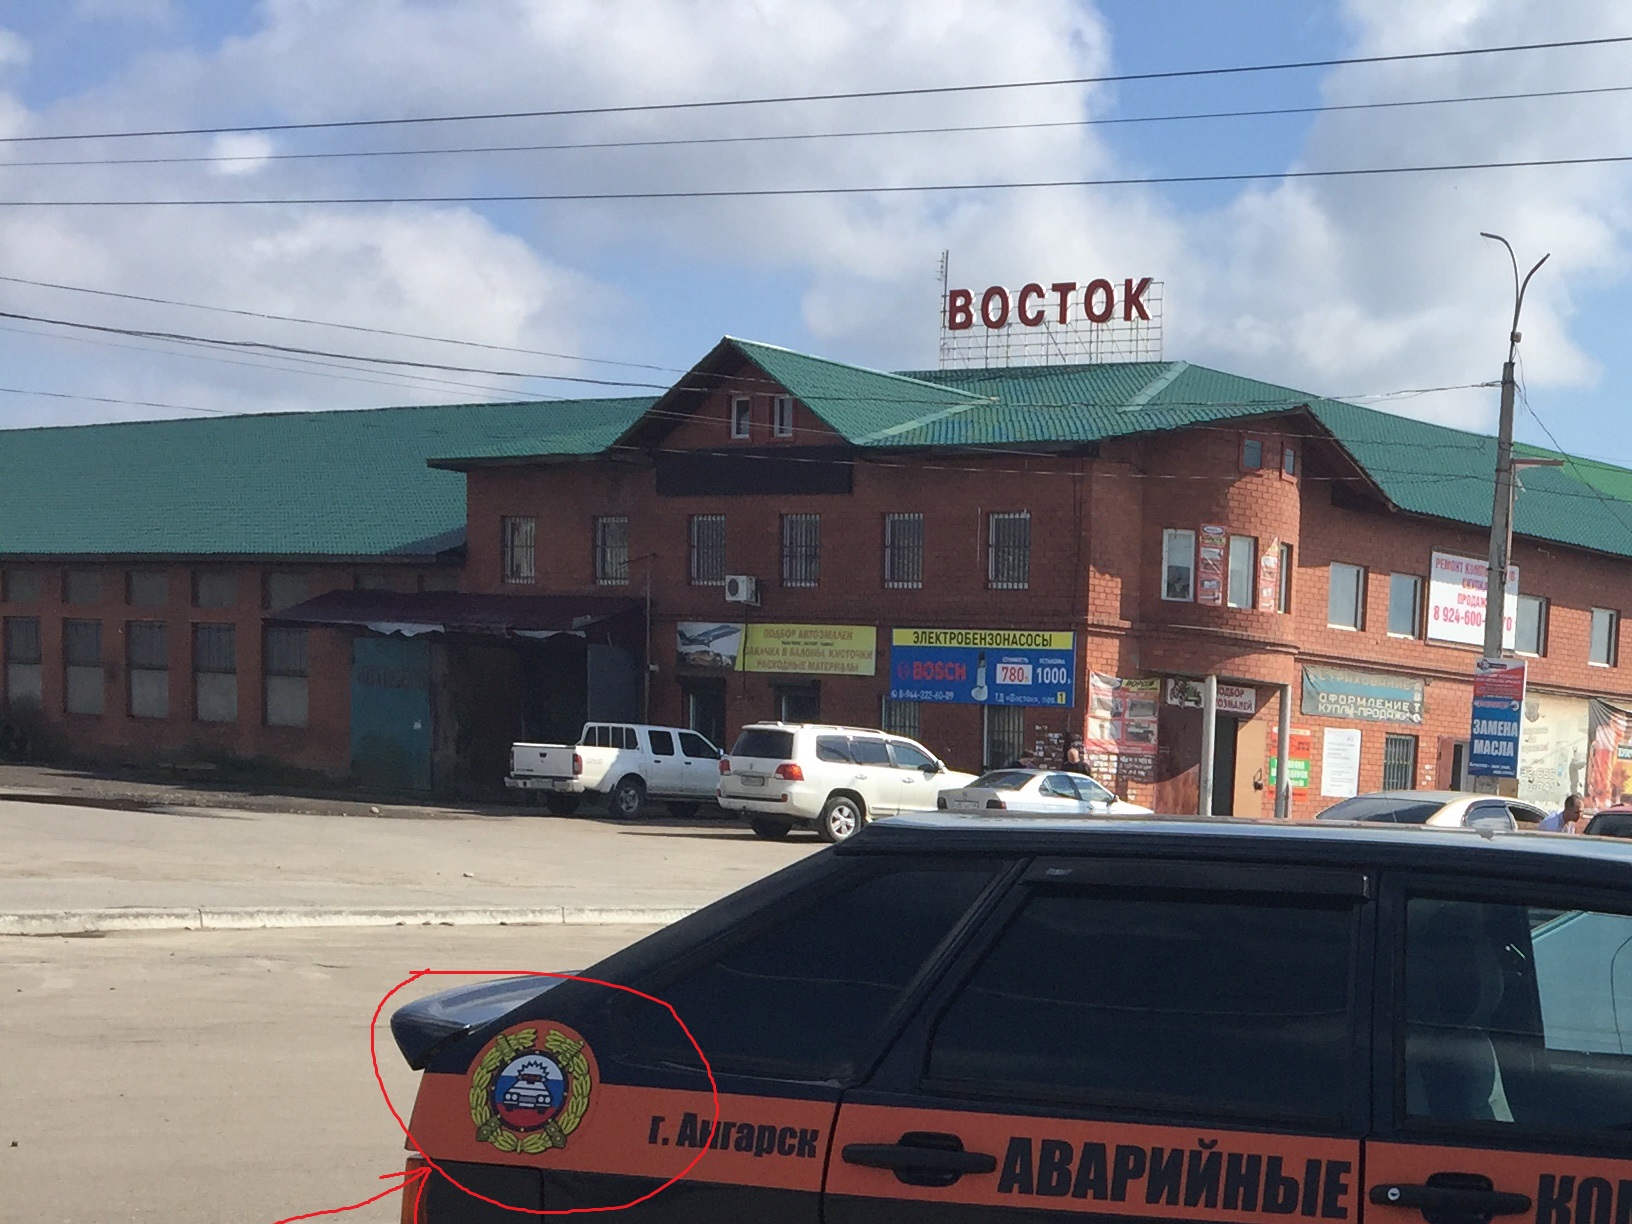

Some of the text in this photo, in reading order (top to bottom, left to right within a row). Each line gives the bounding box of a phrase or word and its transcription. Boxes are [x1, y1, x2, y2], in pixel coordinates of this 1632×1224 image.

[948, 277, 1154, 330] ВОСТОК
[912, 631, 1052, 647] ЭЛЕКТРОБЕНЗОНАСОСЫ
[912, 661, 967, 681] BOSCH
[1001, 666, 1067, 684] 780 1000
[1318, 692, 1410, 712] ОФОРМЛЕНИЕ
[1473, 719, 1518, 737] ЗАМЕНА
[1473, 739, 1514, 757] МАСЛА
[648, 1112, 819, 1158] г. Ангарск
[997, 1136, 1352, 1219] АВАРИЙНЫЕ
